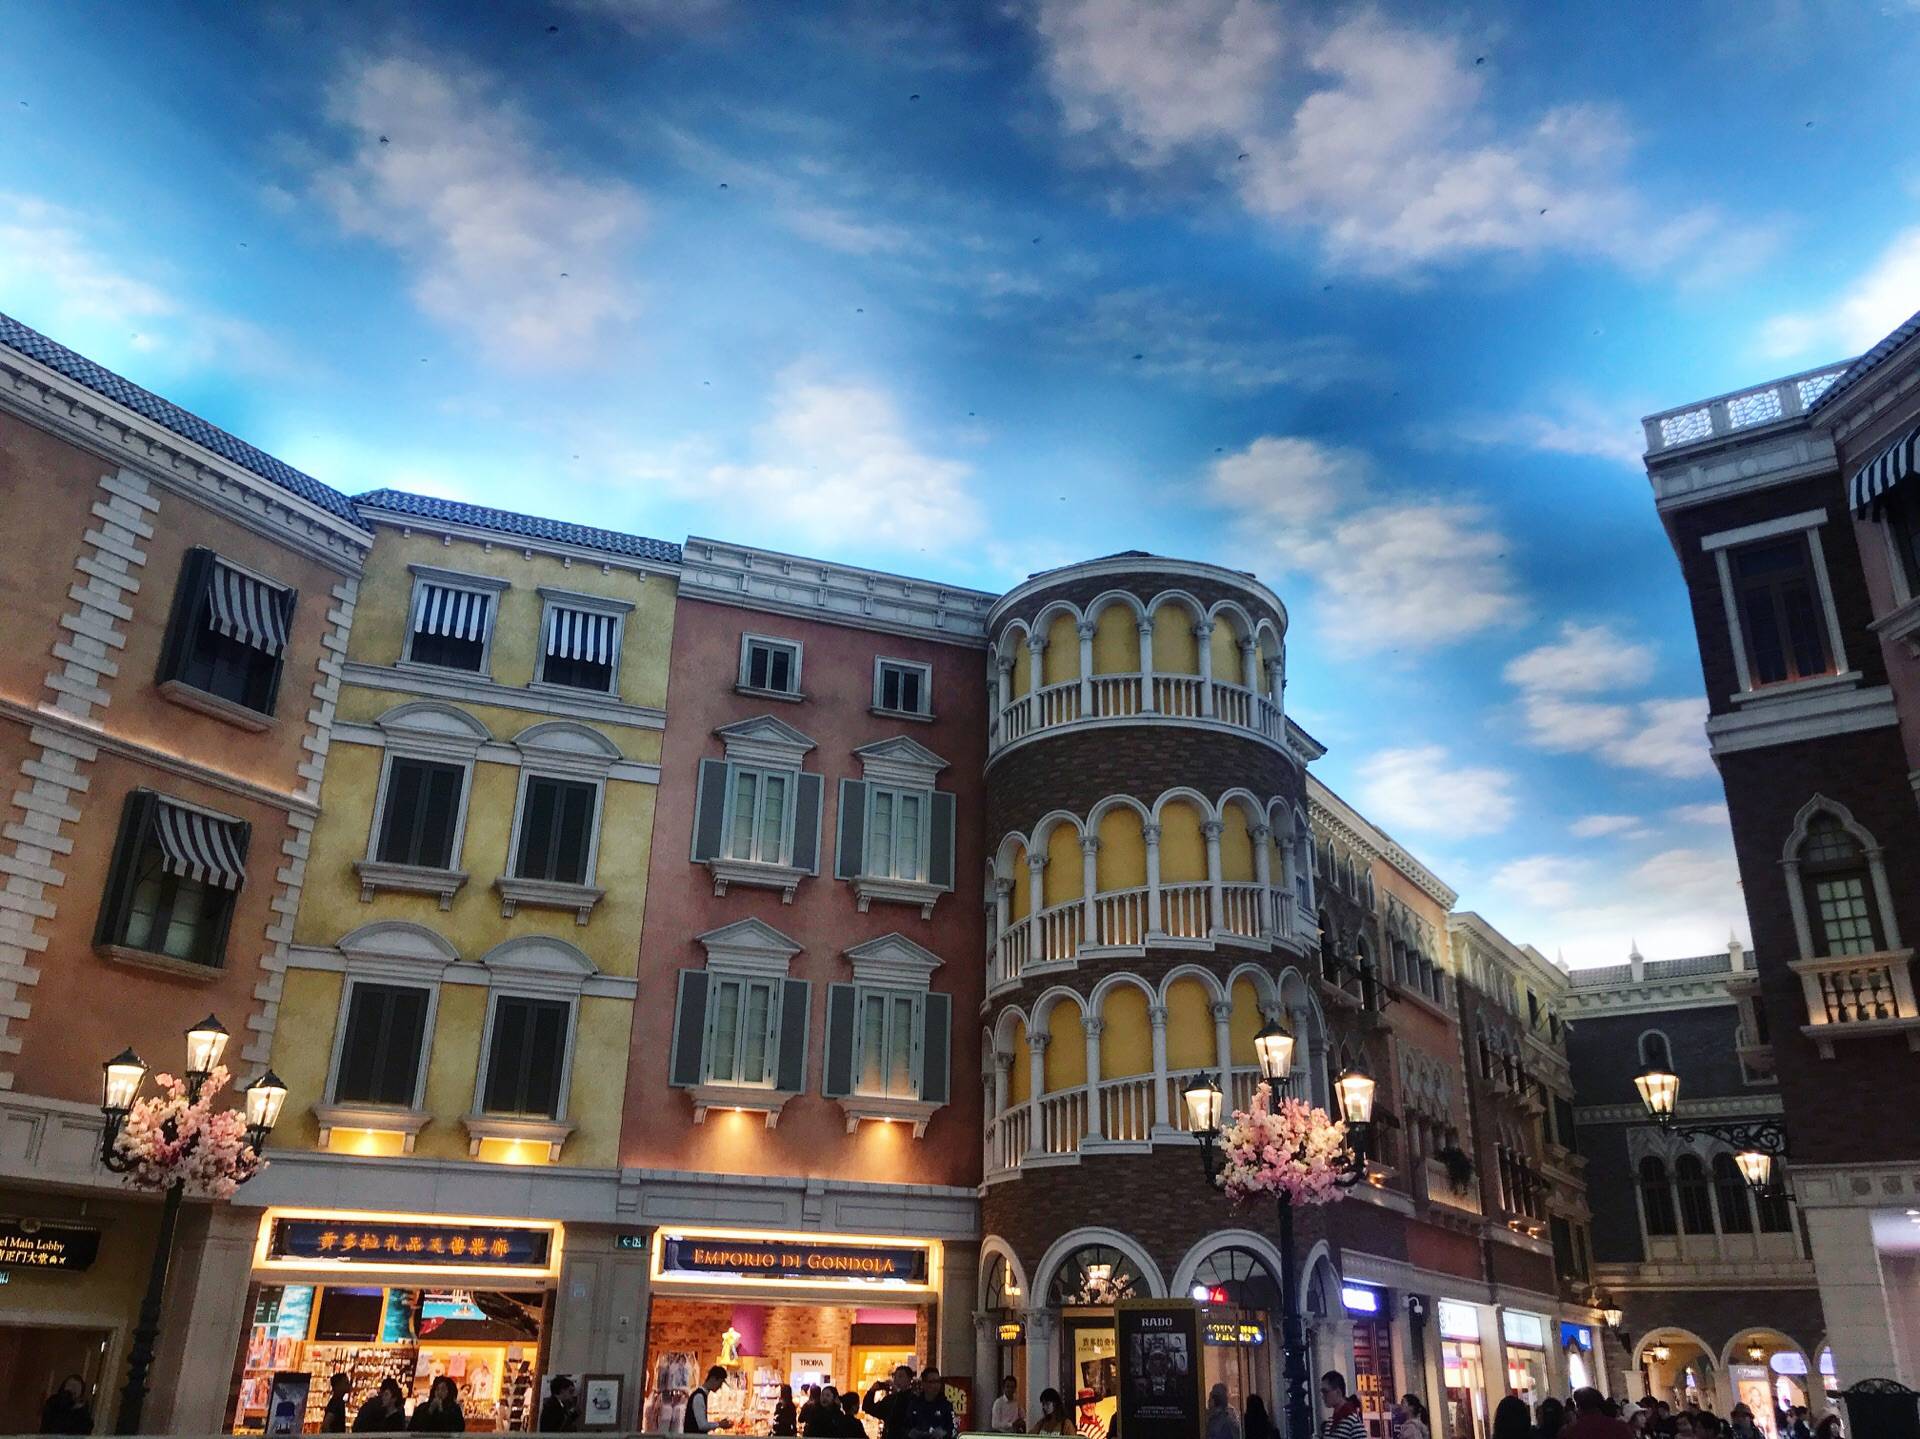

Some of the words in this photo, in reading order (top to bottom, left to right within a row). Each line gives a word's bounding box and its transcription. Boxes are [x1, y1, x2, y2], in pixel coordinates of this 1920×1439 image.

[10, 1237, 34, 1249] Main
[37, 1240, 65, 1253] Lobby
[694, 1249, 775, 1267] EMPORIO
[781, 1254, 800, 1268] DI
[807, 1254, 895, 1272] GONDOLA
[1141, 1317, 1173, 1327] RADO
